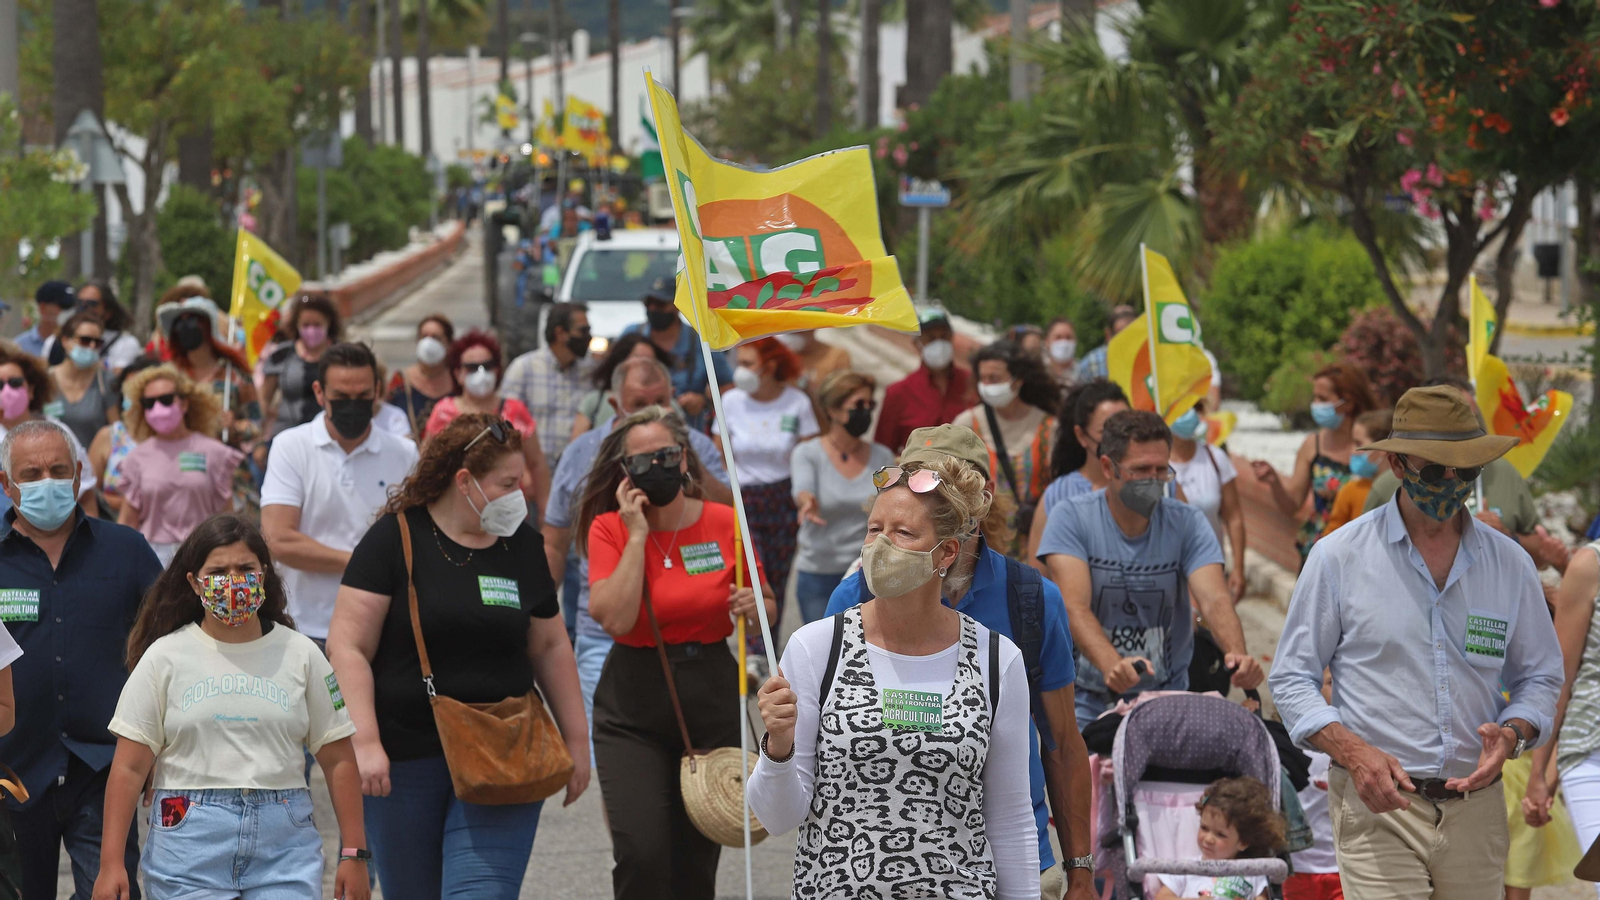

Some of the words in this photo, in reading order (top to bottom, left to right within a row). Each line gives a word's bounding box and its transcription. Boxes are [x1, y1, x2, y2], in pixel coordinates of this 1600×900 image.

[0, 605, 38, 614] GRICULTURA
[1469, 618, 1506, 630] CASTELLAR
[1467, 634, 1505, 650] AGRICULTURA
[182, 674, 290, 712] COLORADO
[884, 691, 940, 703] CASTELLAR
[905, 700, 941, 708] FRONTERA
[883, 708, 941, 724] AGRICULTURA
